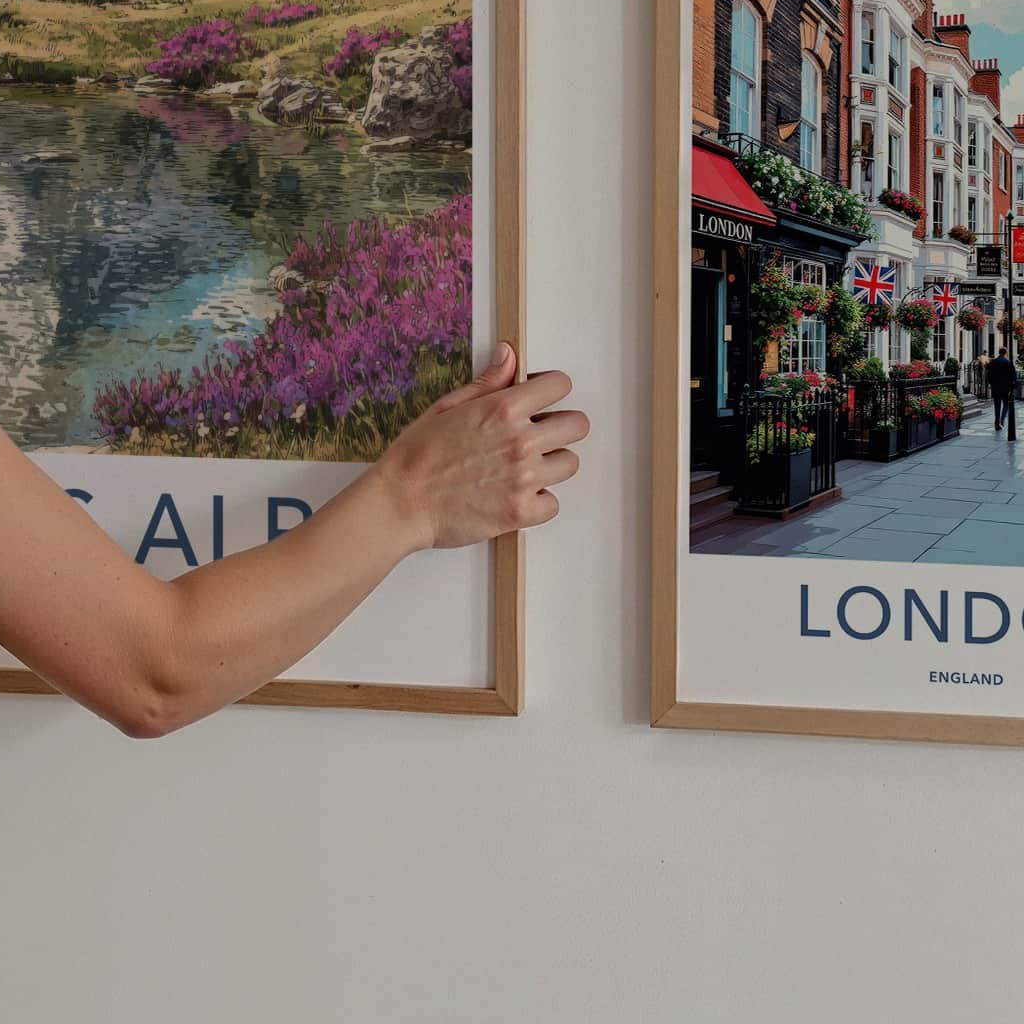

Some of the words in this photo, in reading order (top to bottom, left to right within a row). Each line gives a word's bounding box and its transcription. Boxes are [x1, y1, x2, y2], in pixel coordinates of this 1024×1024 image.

[699, 213, 753, 242] LONDON
[800, 584, 1024, 645] LOND
[929, 671, 1004, 686] ENGLAND
